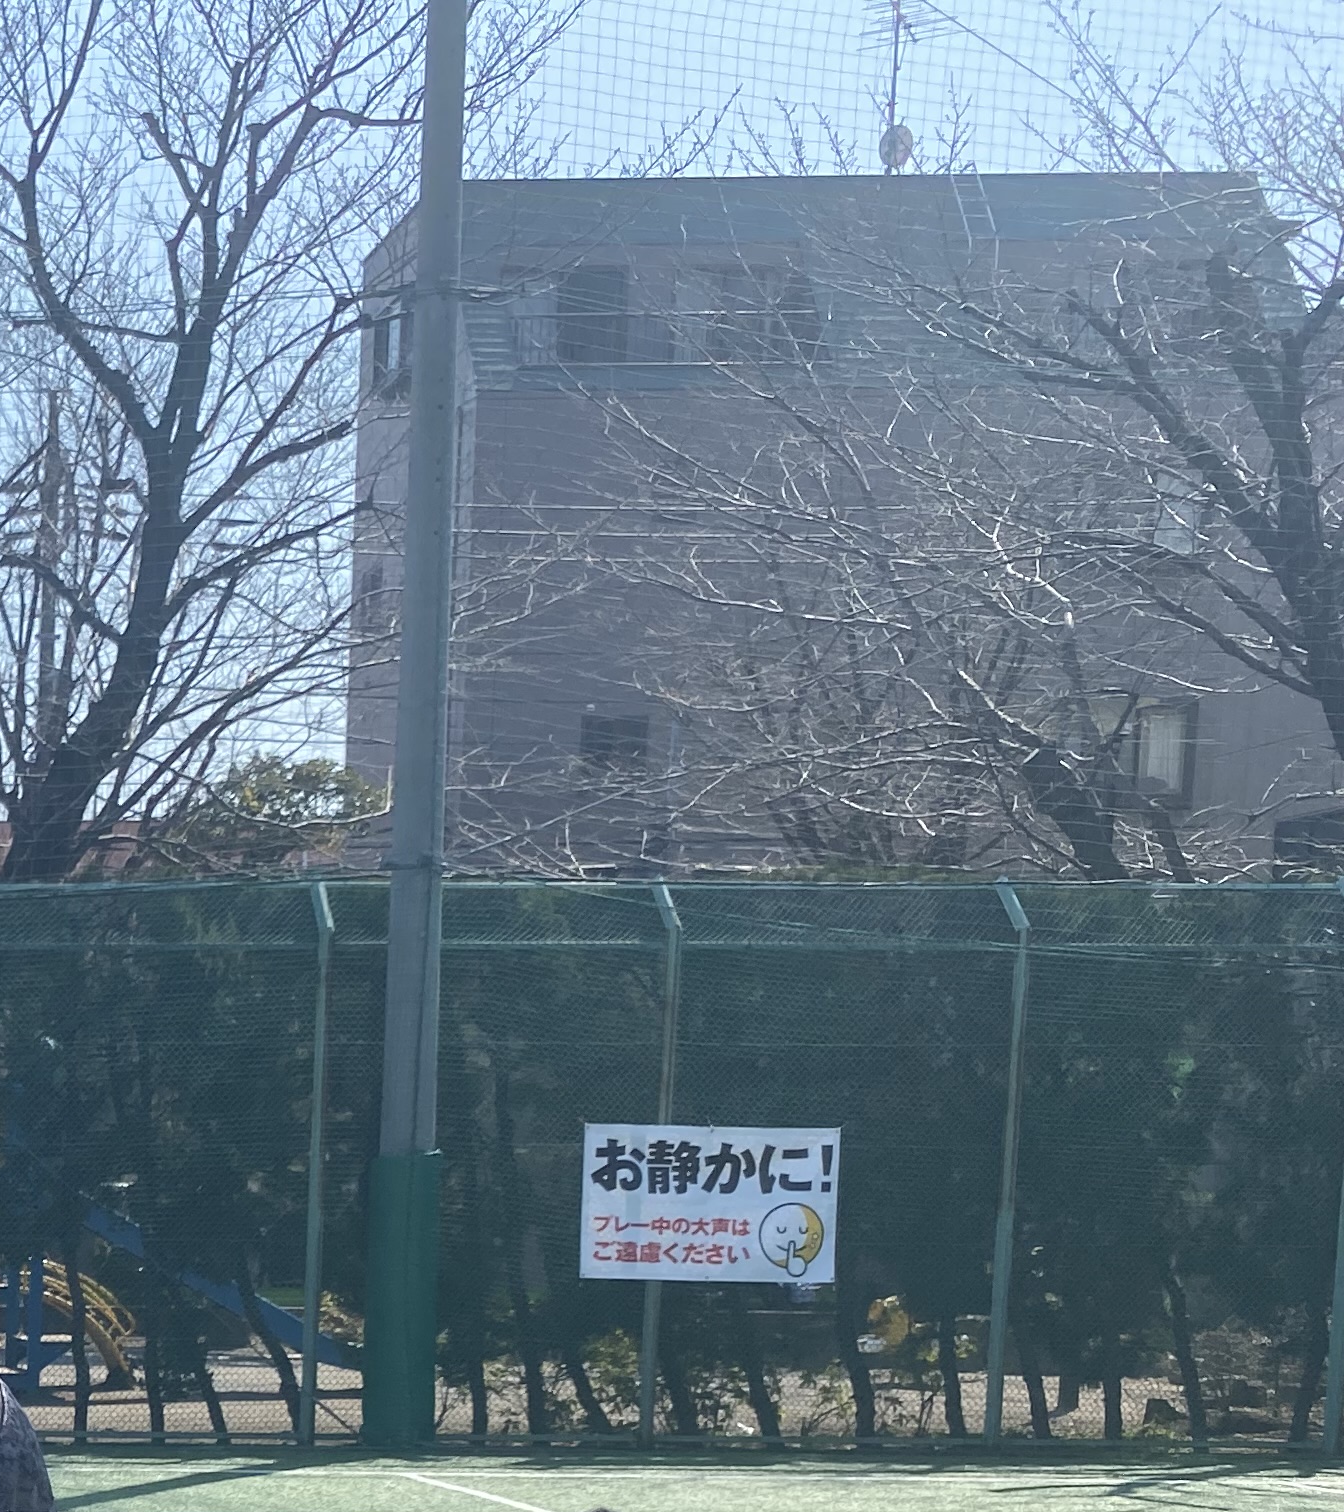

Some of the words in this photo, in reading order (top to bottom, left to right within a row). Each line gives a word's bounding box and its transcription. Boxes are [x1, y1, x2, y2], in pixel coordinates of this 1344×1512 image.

[590, 1138, 834, 1195] お静かに!
[592, 1216, 751, 1237] プレー中の大声は
[592, 1241, 751, 1265] ご遠慮ください
